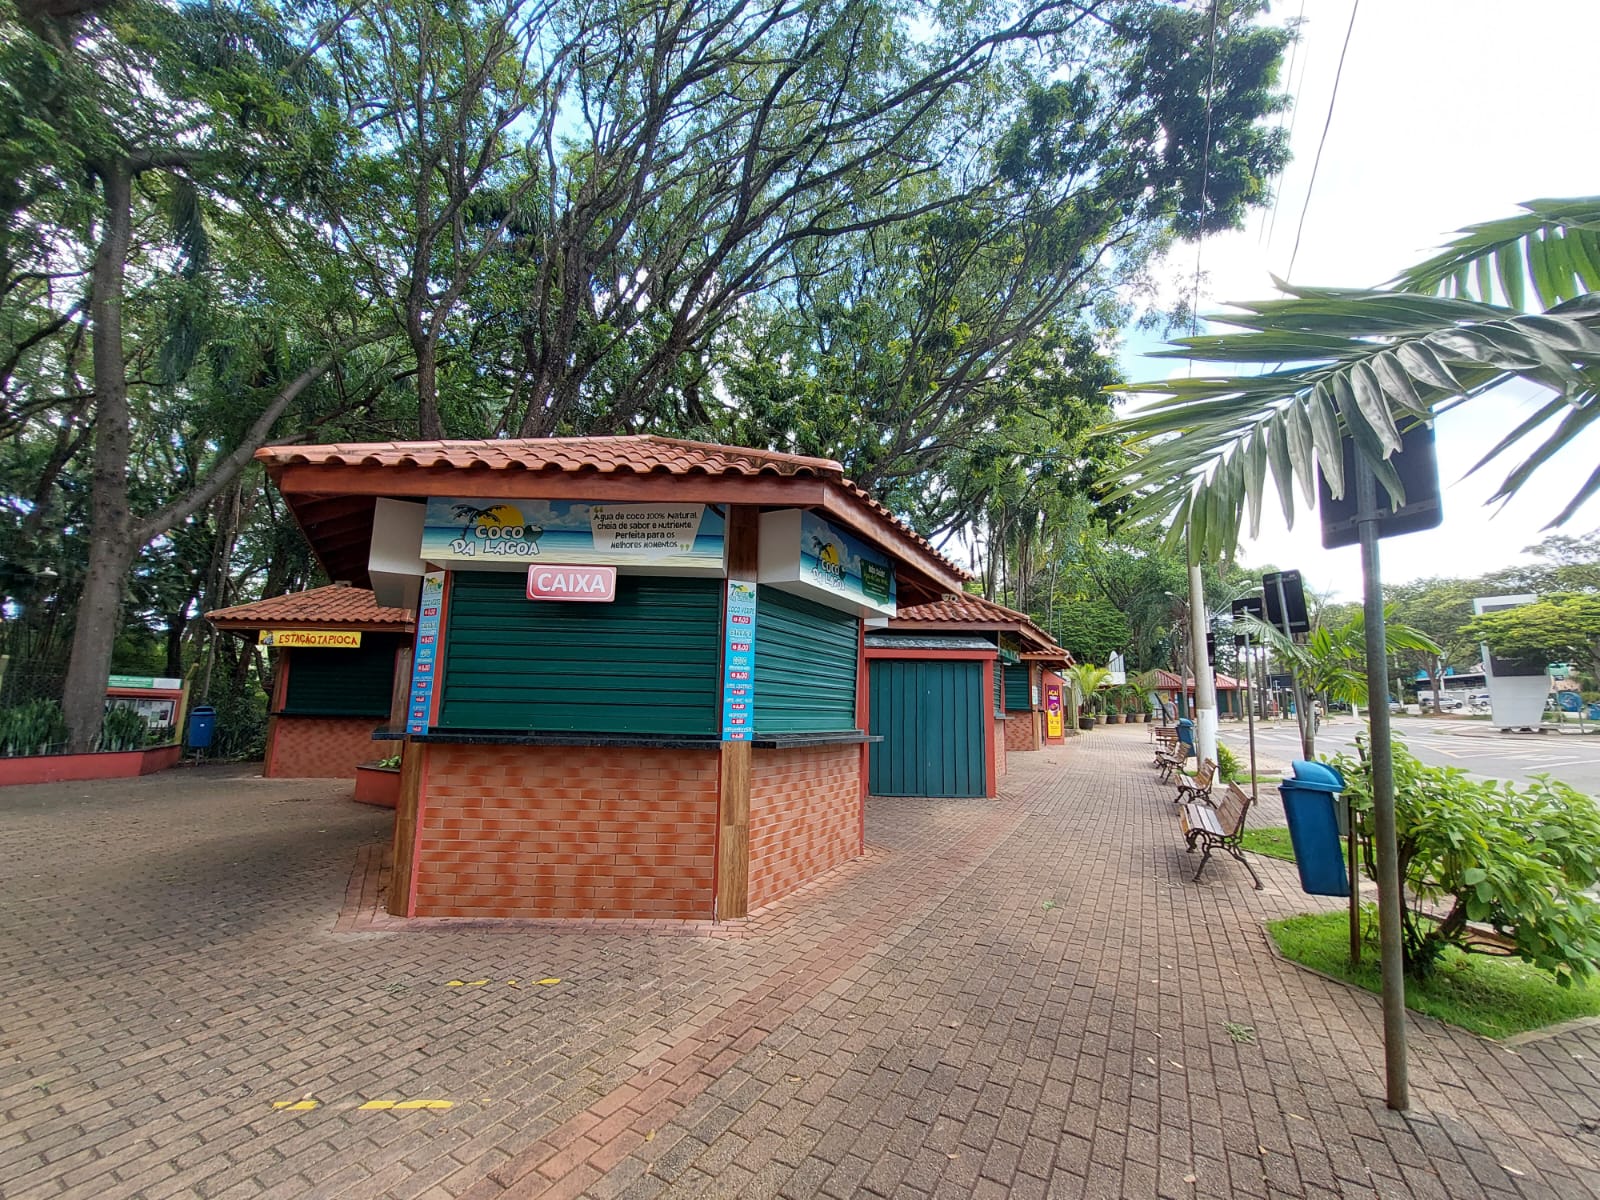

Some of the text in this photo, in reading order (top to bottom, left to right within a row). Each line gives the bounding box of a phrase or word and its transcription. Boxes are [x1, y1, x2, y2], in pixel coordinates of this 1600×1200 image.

[615, 512, 625, 520] de
[646, 512, 665, 520] 100%
[667, 511, 697, 519] Natural
[475, 525, 524, 539] COCO
[597, 521, 617, 530] cheia
[618, 521, 629, 530] de
[629, 521, 651, 529] sabor
[615, 530, 676, 541] Perfeita para os
[449, 538, 540, 556] DA LAGOA
[821, 559, 840, 575] COCO
[538, 573, 606, 593] CAIXA
[278, 633, 358, 645] ESTAÇÃO TAPIOCA
